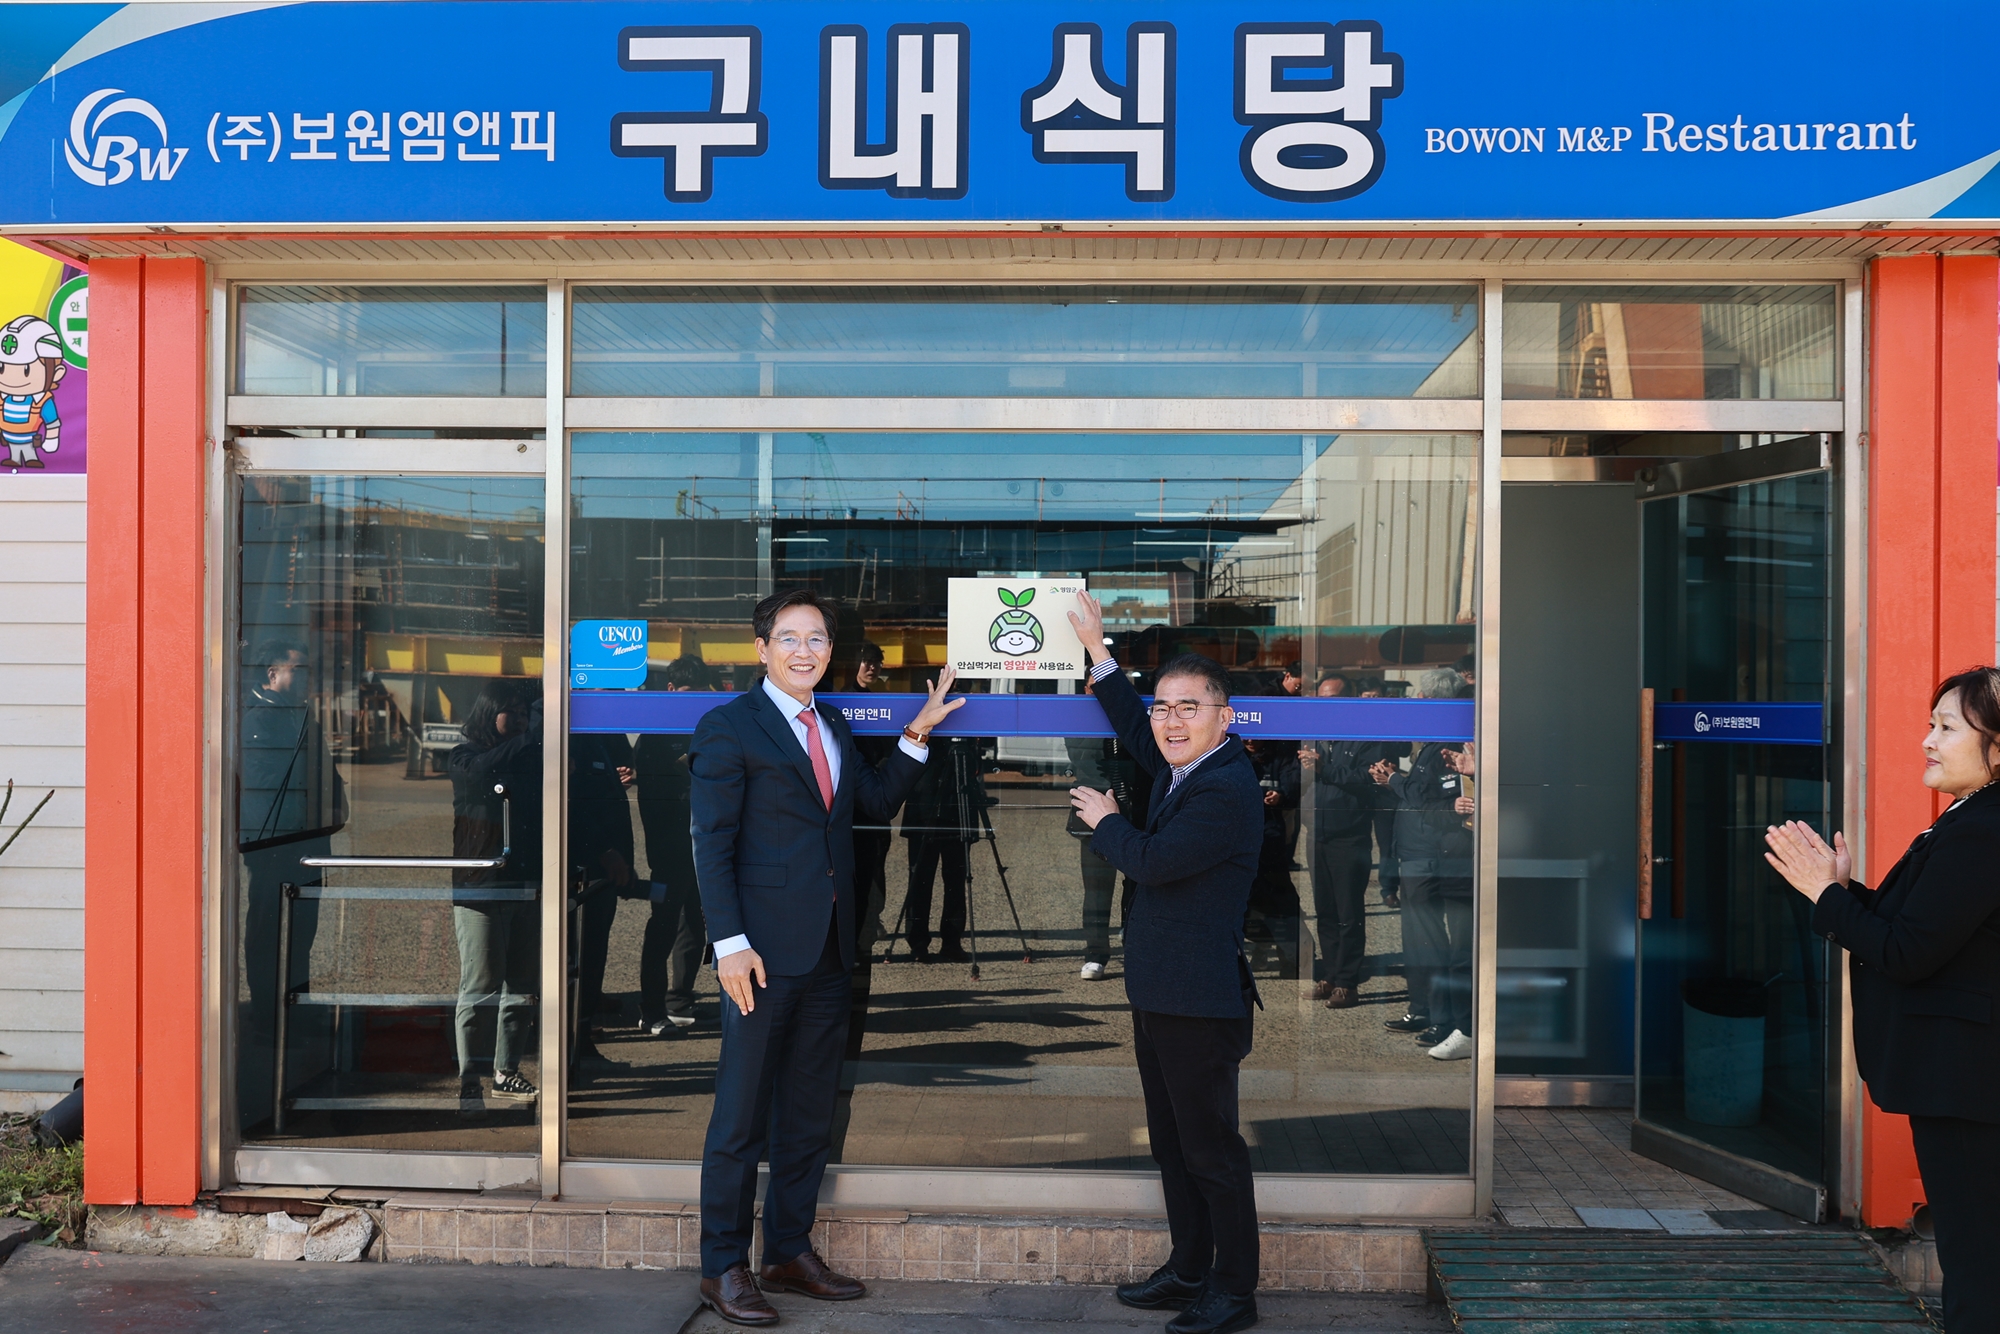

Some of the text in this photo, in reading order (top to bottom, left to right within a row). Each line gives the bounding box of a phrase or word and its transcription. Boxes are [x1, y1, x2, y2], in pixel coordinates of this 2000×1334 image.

[616, 26, 1397, 196] 구내식당
[206, 110, 557, 163] (주)보원엠앤피
[1424, 112, 1917, 154] BOWON M&P Restaurant
[70, 301, 80, 312] 안
[598, 626, 642, 642] CESCO
[612, 643, 643, 656] Members
[957, 660, 1075, 671] 안심먹거리 영암쌀 사용업소
[842, 707, 891, 721] 원엠앤피
[1711, 716, 1760, 729] (주)보원엠앤피
